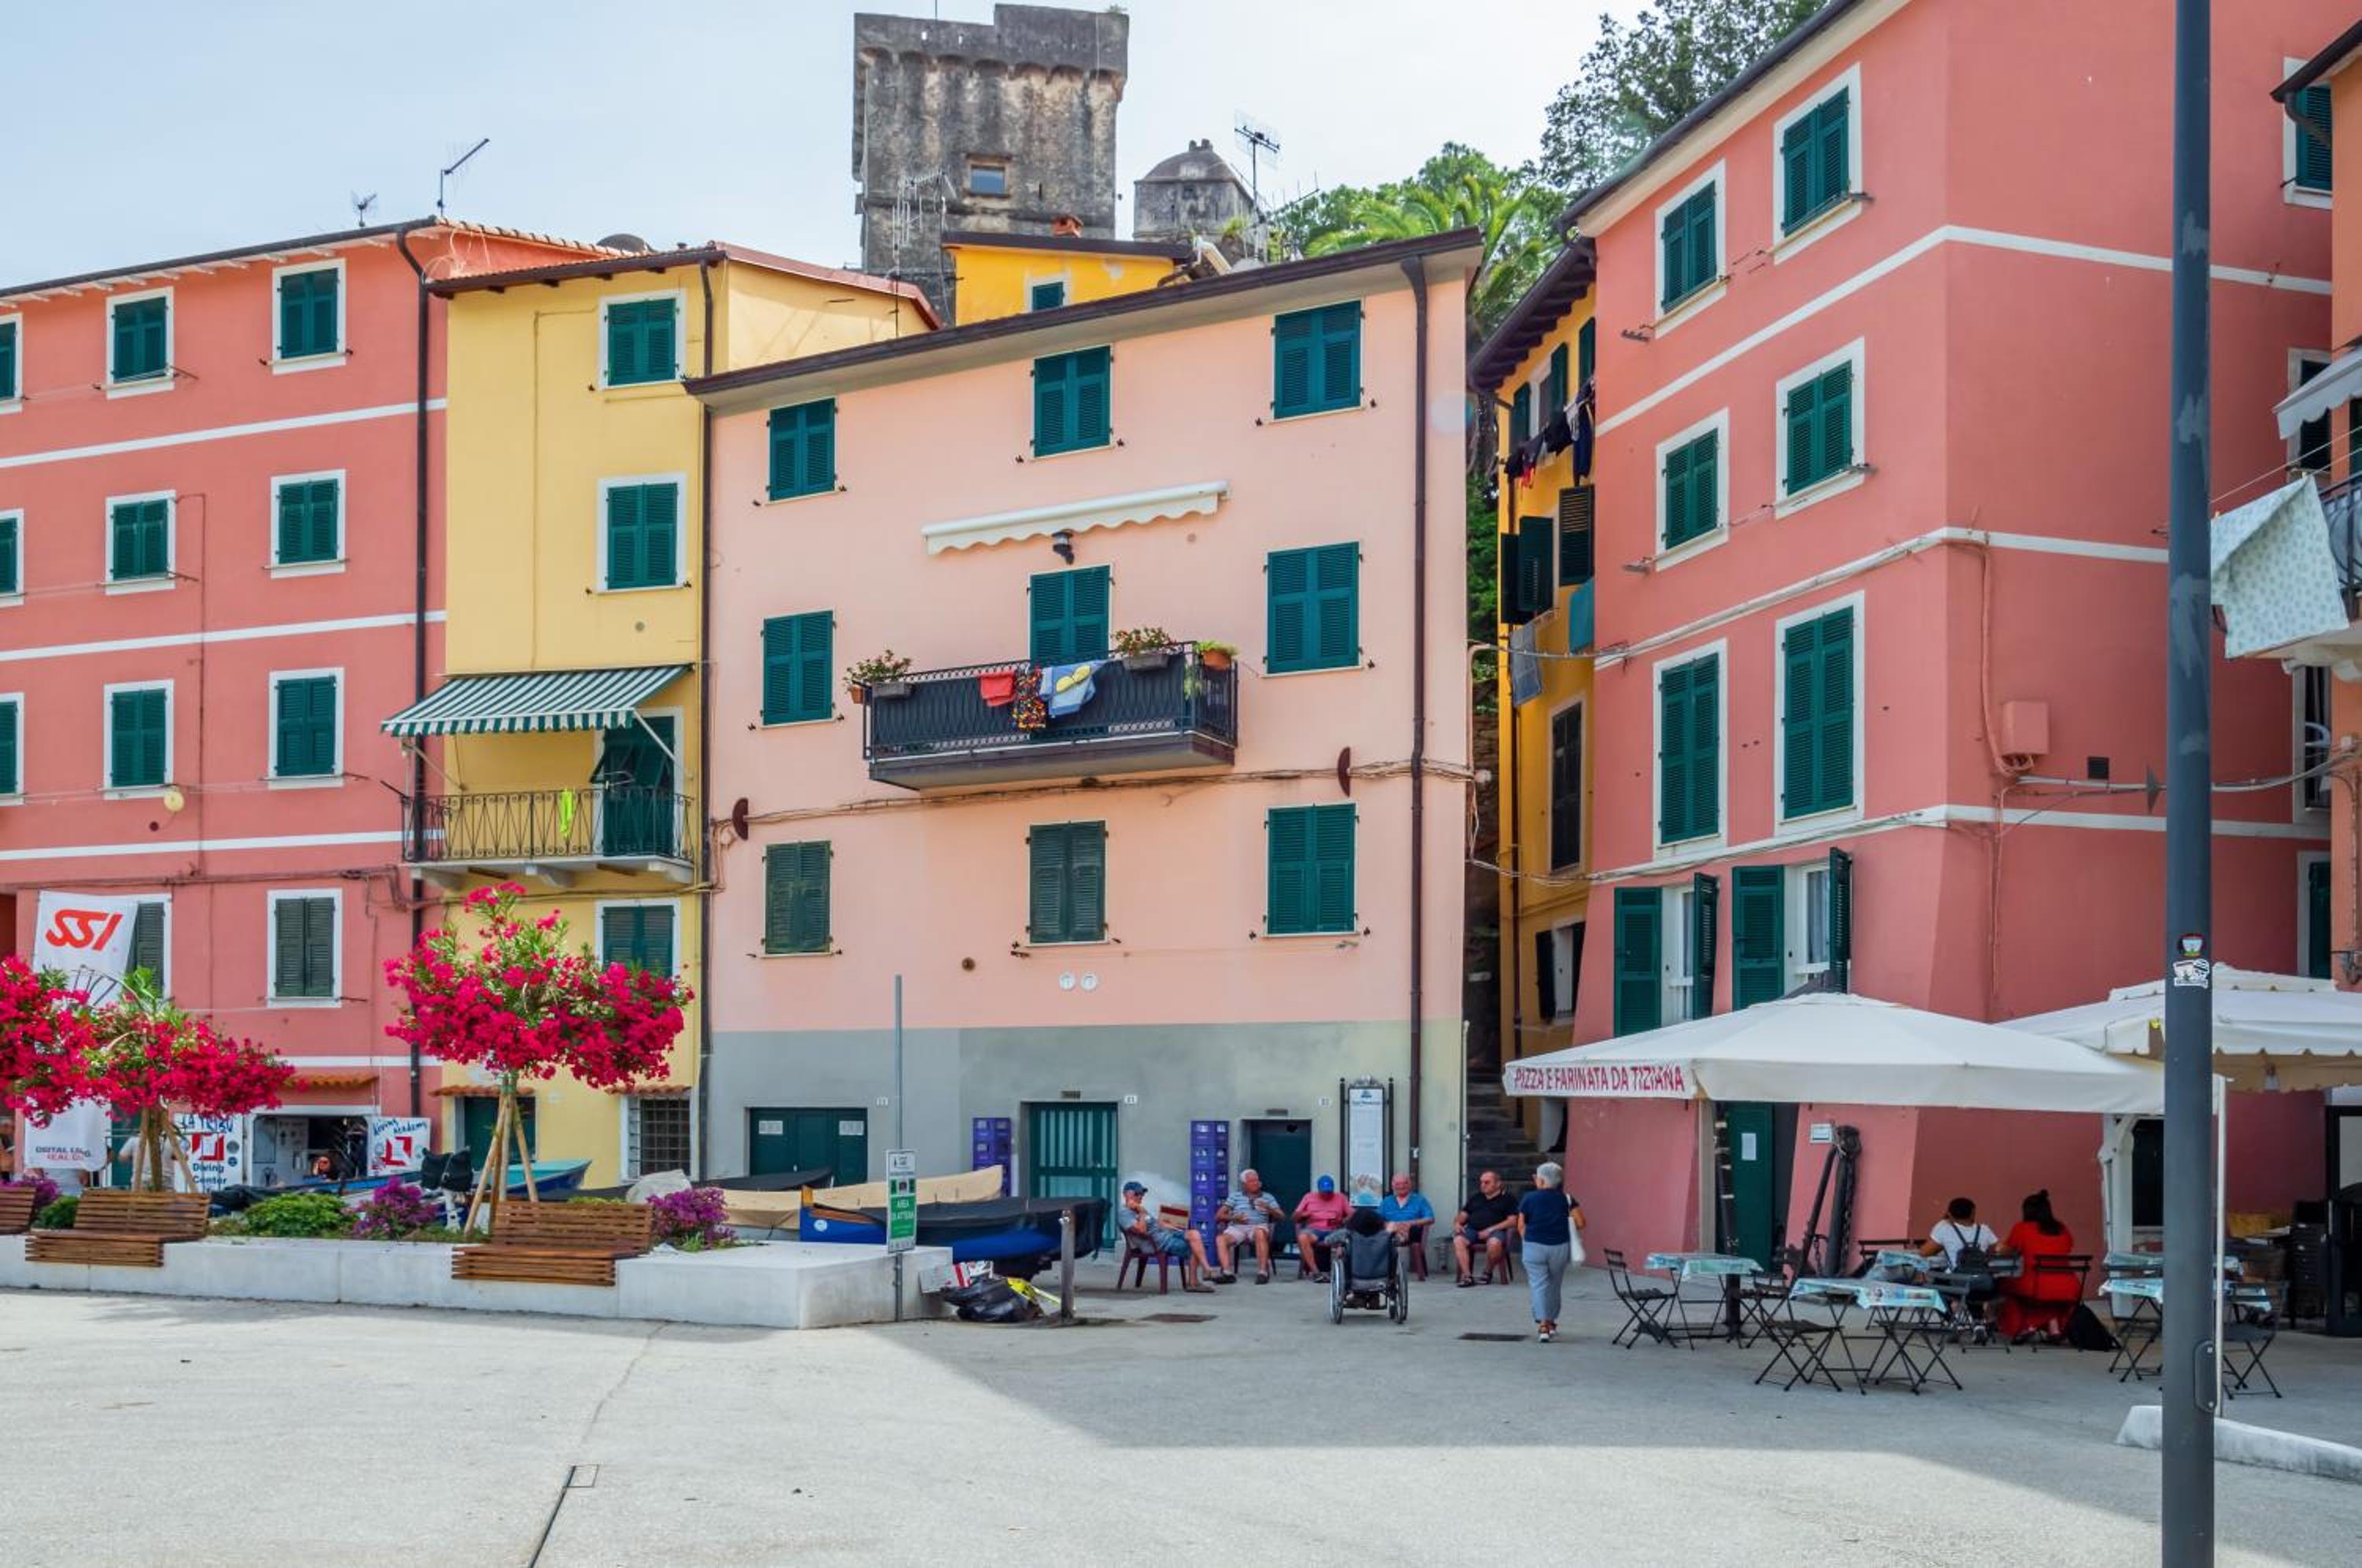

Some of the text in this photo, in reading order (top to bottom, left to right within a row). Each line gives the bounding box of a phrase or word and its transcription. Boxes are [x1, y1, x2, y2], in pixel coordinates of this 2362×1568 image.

[46, 909, 123, 951] SSI
[1514, 1065, 1685, 1092] PIZZA E FARINATA DA TIZIANA
